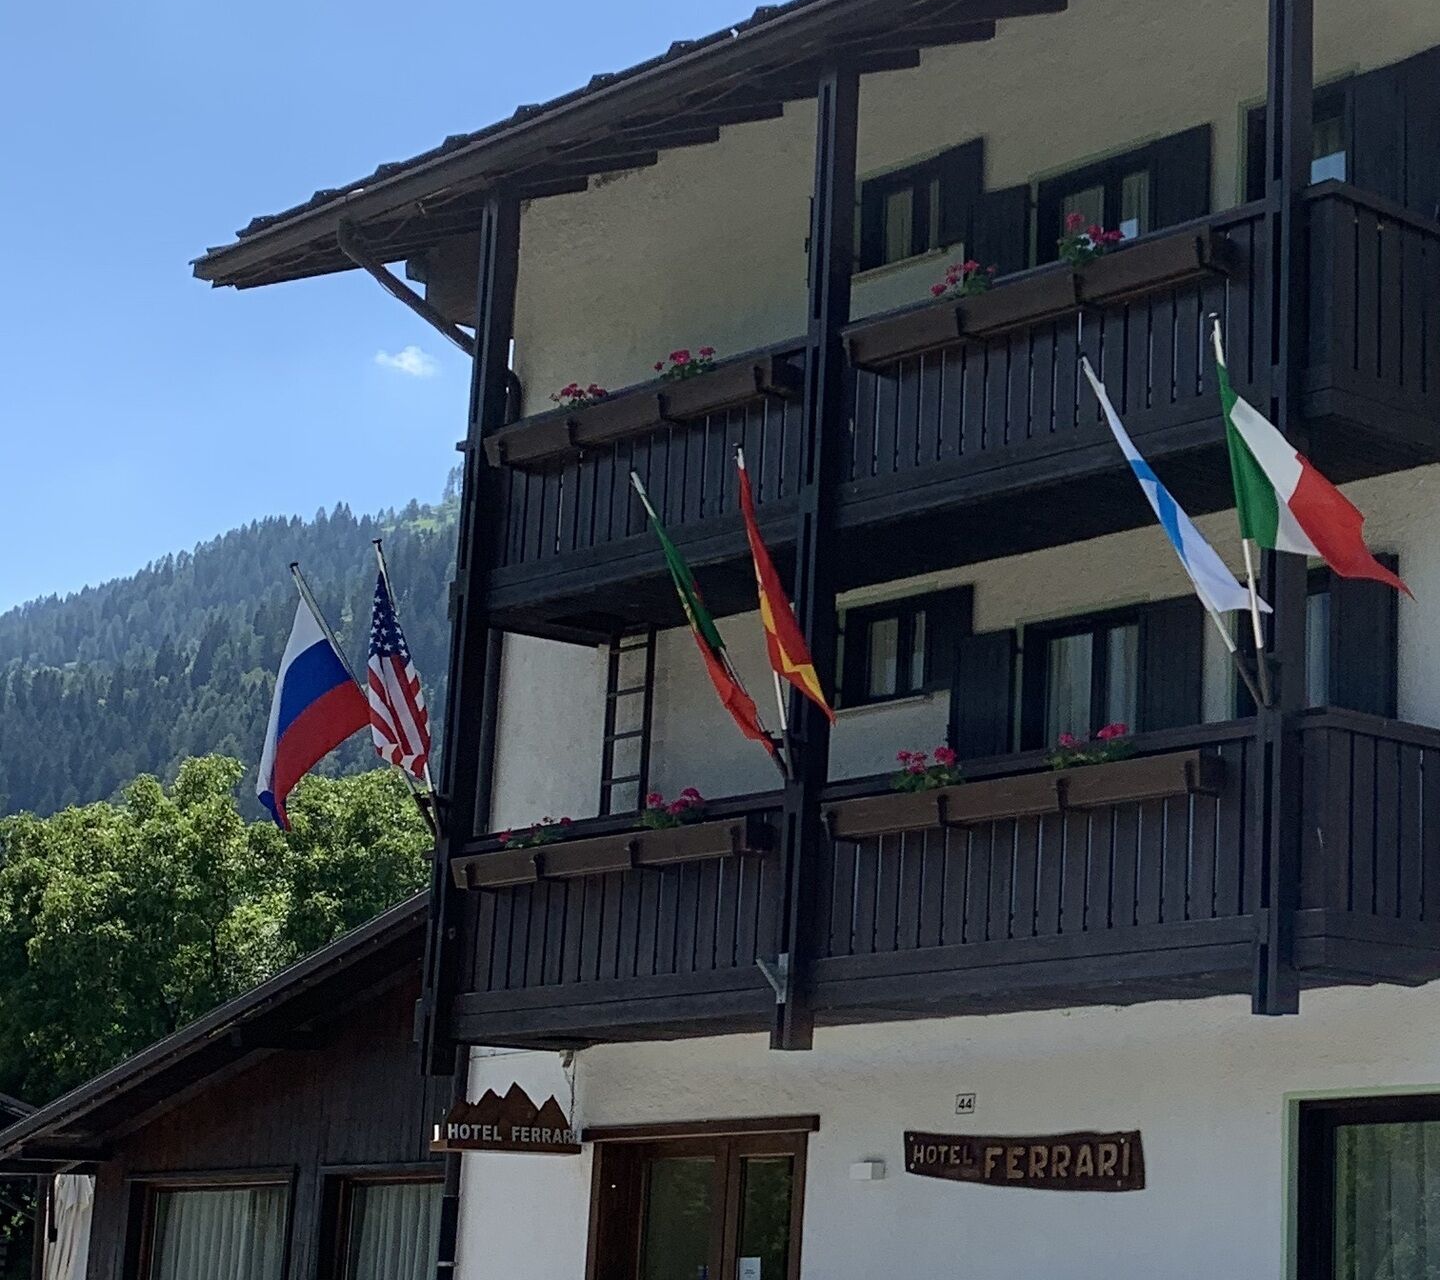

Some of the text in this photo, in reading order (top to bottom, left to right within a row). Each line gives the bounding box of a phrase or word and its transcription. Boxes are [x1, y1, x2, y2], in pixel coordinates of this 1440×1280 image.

[958, 1098, 972, 1110] 44
[447, 1122, 502, 1141] HOTEL
[913, 1142, 1130, 1179] HOTEL FERRARI
